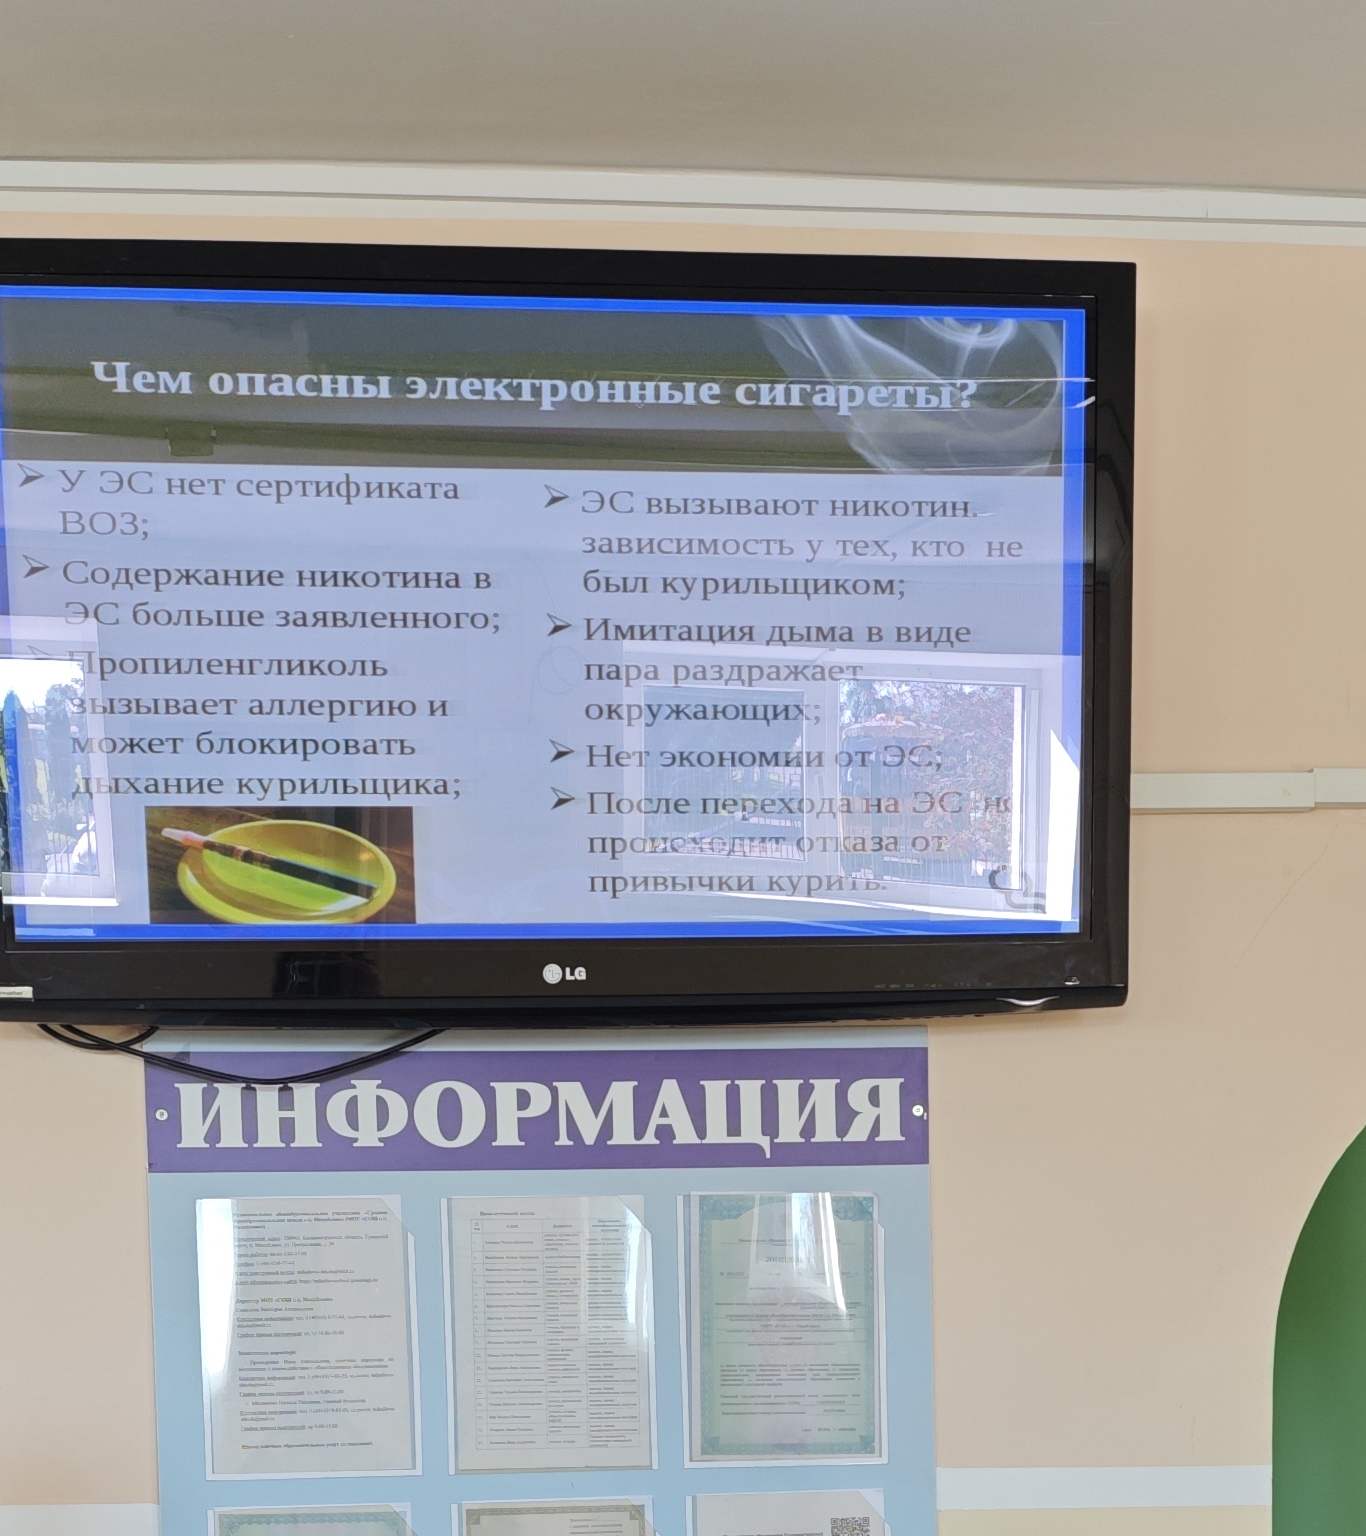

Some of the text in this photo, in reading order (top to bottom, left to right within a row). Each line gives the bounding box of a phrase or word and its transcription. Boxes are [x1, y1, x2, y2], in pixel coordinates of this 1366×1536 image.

[91, 360, 978, 416] Чем опасны электронные сигареты?
[59, 468, 459, 504] У ЭС нет сертификата
[581, 490, 978, 519] ЭС вызывают никотин.
[59, 509, 149, 540] ВОЗ;
[582, 533, 1024, 563] зависимость у тех, кто не
[62, 559, 492, 591] Содержание никотина в
[583, 570, 907, 602] был курильщиком;
[64, 601, 502, 635] ЭС больше заявленного;
[584, 616, 972, 647] Имитация дыма в виде
[69, 650, 388, 682] Пропиленгликоль
[584, 661, 864, 690] пара раздражает
[72, 696, 449, 723] вызывает аллергию и
[585, 701, 822, 728] окружающих;
[70, 730, 415, 762] может блокировать
[586, 744, 943, 772] Нет экономии от ЭС;
[71, 774, 462, 802] дыхание курильщика;
[587, 790, 691, 815] После
[701, 793, 853, 821] перехода
[862, 795, 900, 815] на
[912, 791, 964, 815] ЭС
[796, 833, 898, 854] отказа
[911, 833, 949, 854] от
[589, 872, 888, 900] привычки курить.
[174, 1077, 906, 1161] ИНФОРМАЦИЯ
